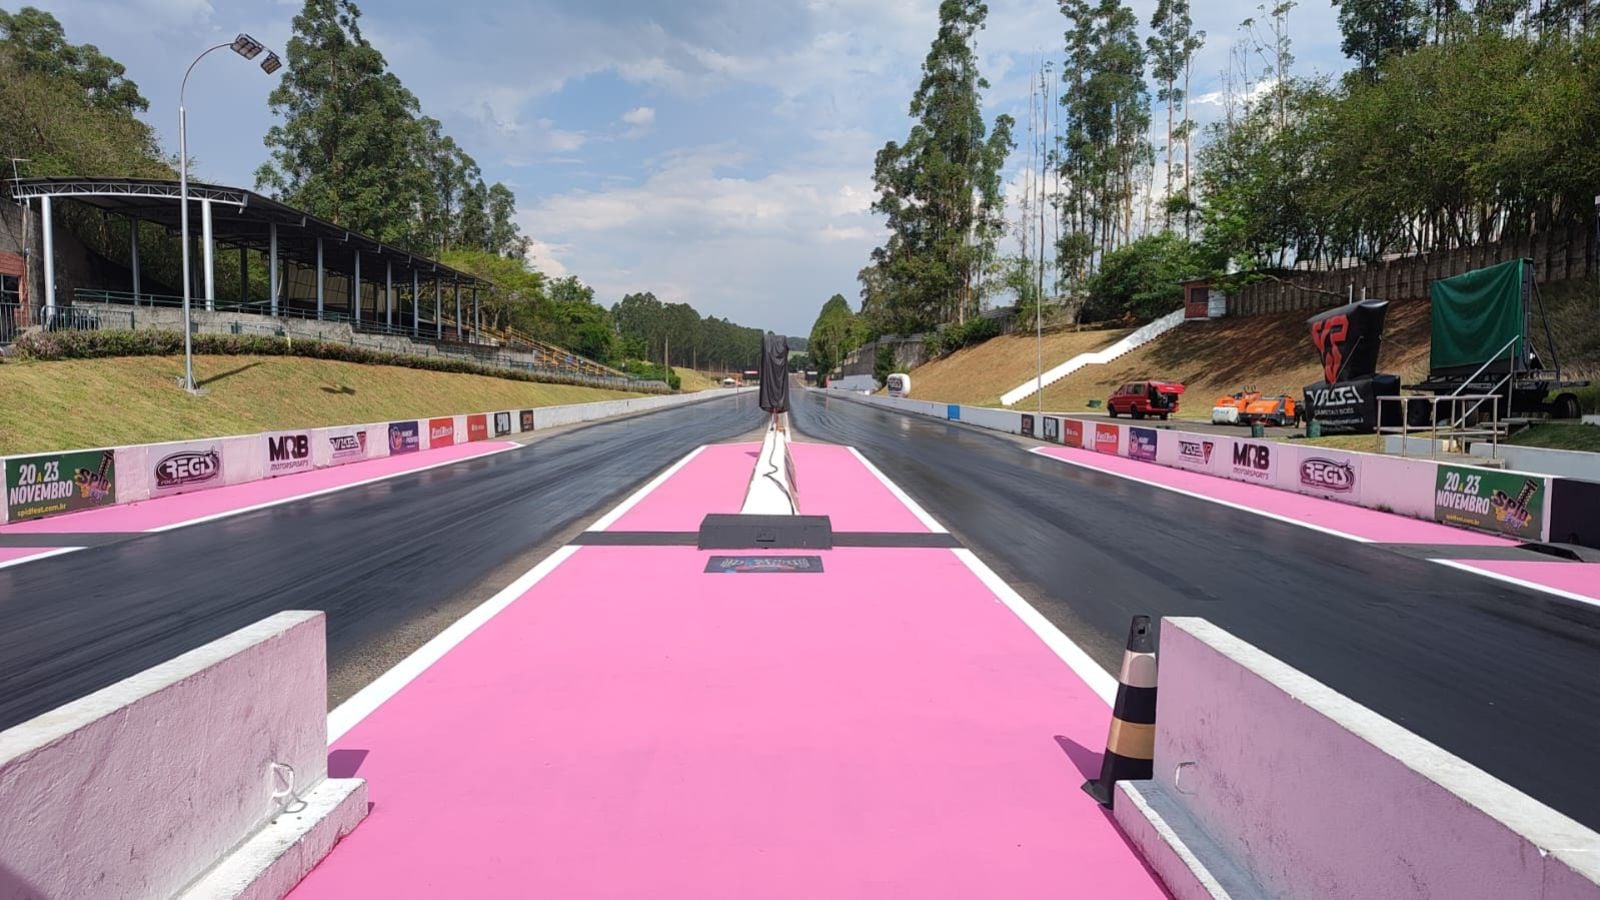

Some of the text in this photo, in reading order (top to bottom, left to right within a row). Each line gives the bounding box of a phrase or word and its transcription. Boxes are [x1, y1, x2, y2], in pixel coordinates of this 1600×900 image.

[268, 434, 309, 462] MRB
[1233, 442, 1270, 470] MRB
[19, 460, 60, 486] 20 A 23
[270, 459, 309, 472] MOTORSPORTS
[1233, 466, 1270, 481] MOTORSPORTS
[9, 479, 73, 506] NOVEMBRO
[1444, 471, 1460, 492] 20
[1464, 475, 1481, 494] 23
[1436, 489, 1490, 515] NOVEMBRO
